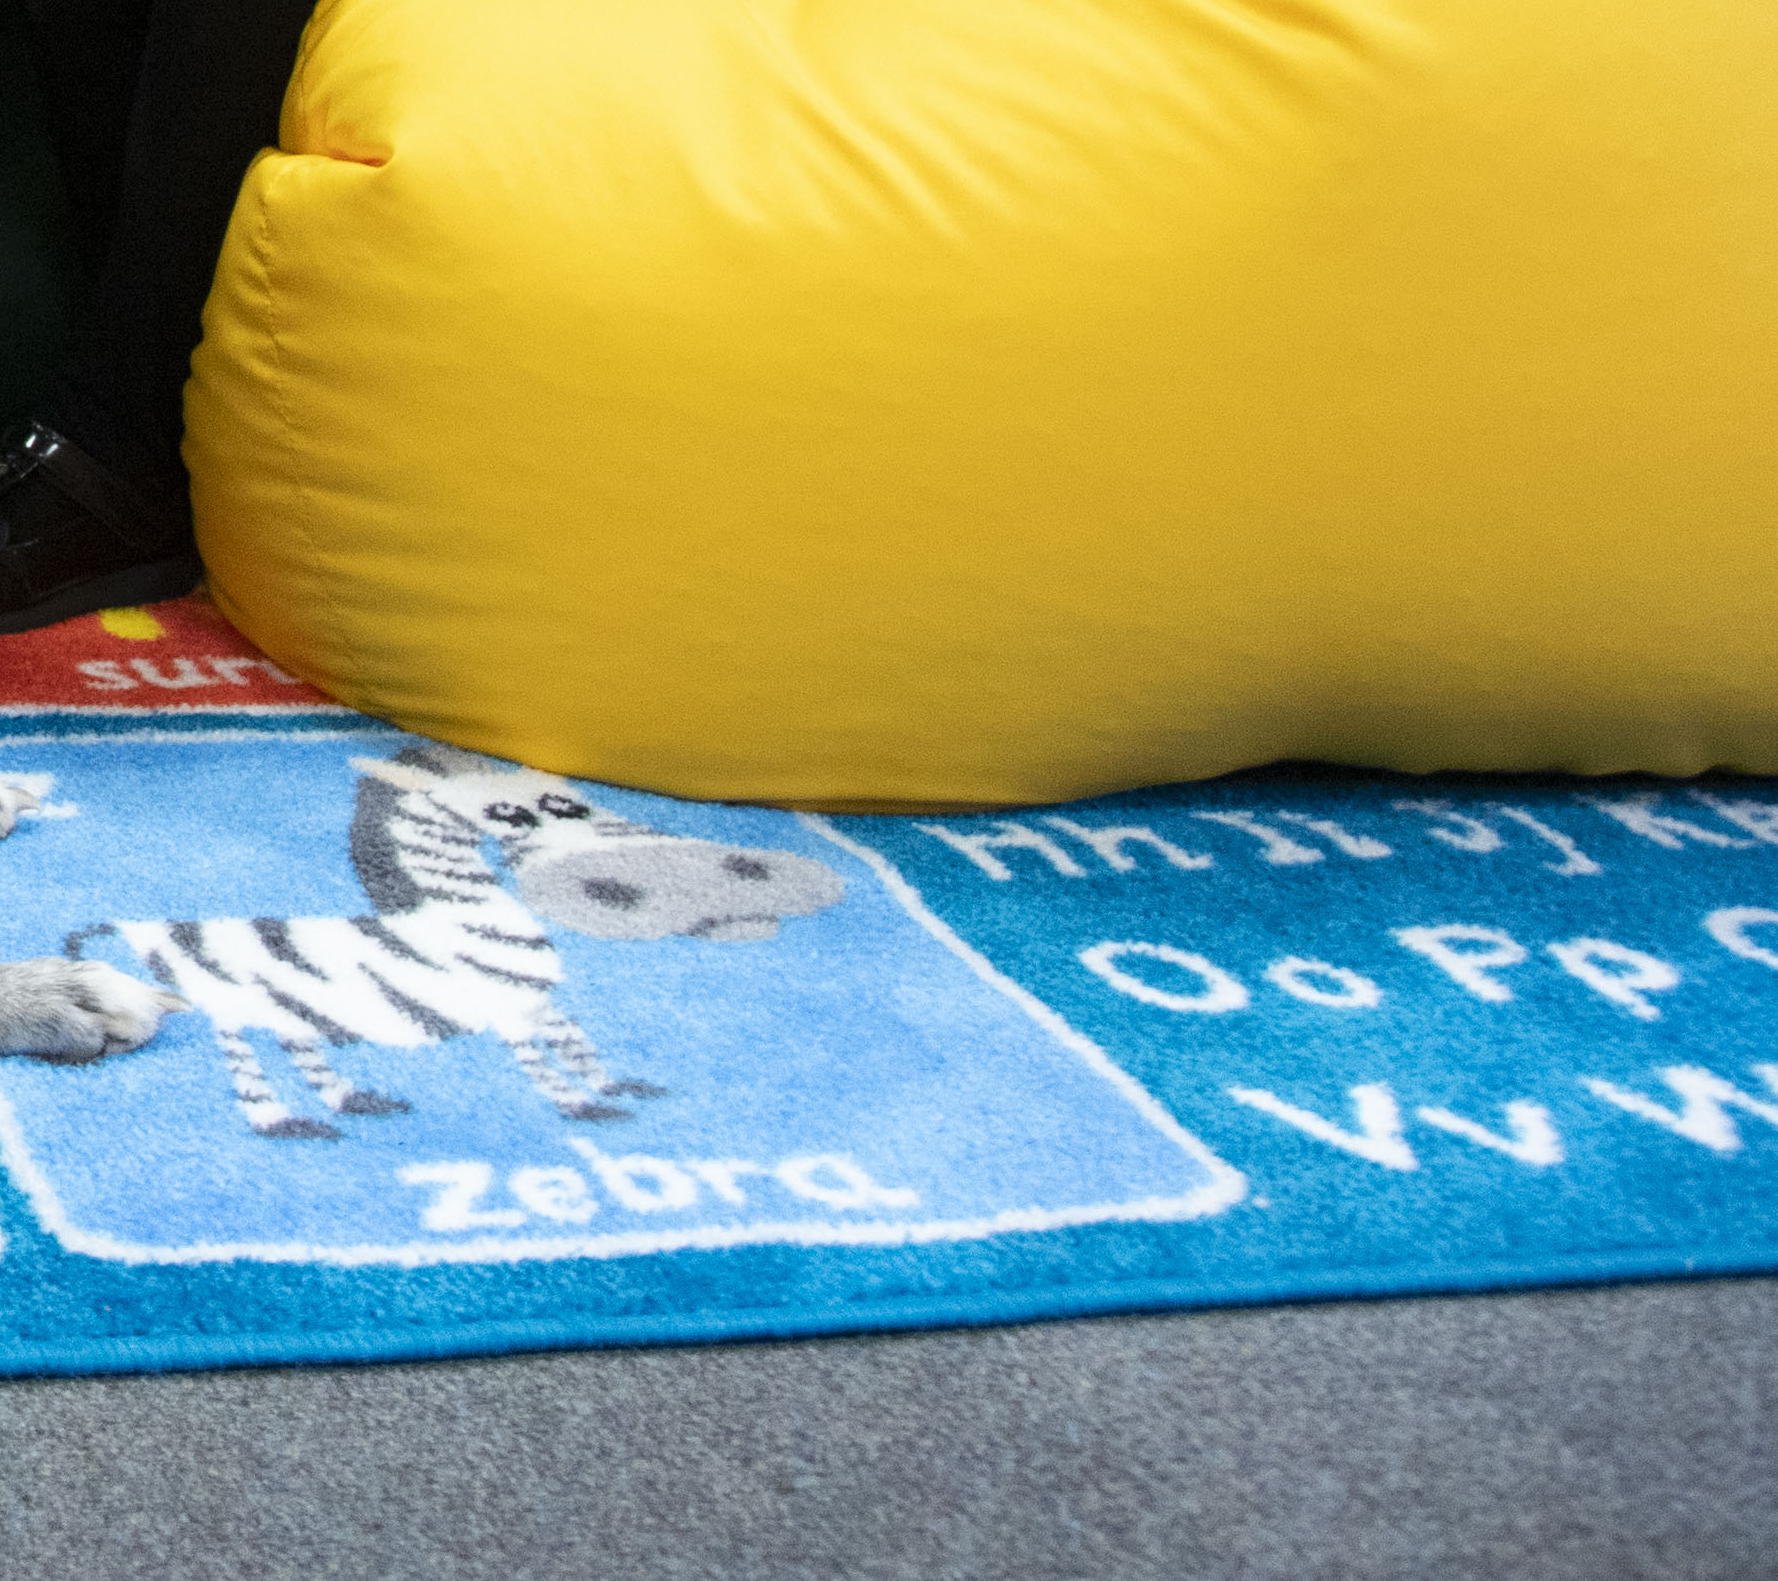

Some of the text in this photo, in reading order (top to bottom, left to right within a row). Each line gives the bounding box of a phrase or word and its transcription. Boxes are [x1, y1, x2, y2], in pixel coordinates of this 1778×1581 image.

[76, 654, 301, 691] sun
[1076, 939, 1384, 1015] Oo
[1389, 923, 1681, 1021] Pp
[1227, 1080, 1565, 1172] Vv
[395, 1137, 919, 1234] zebra
